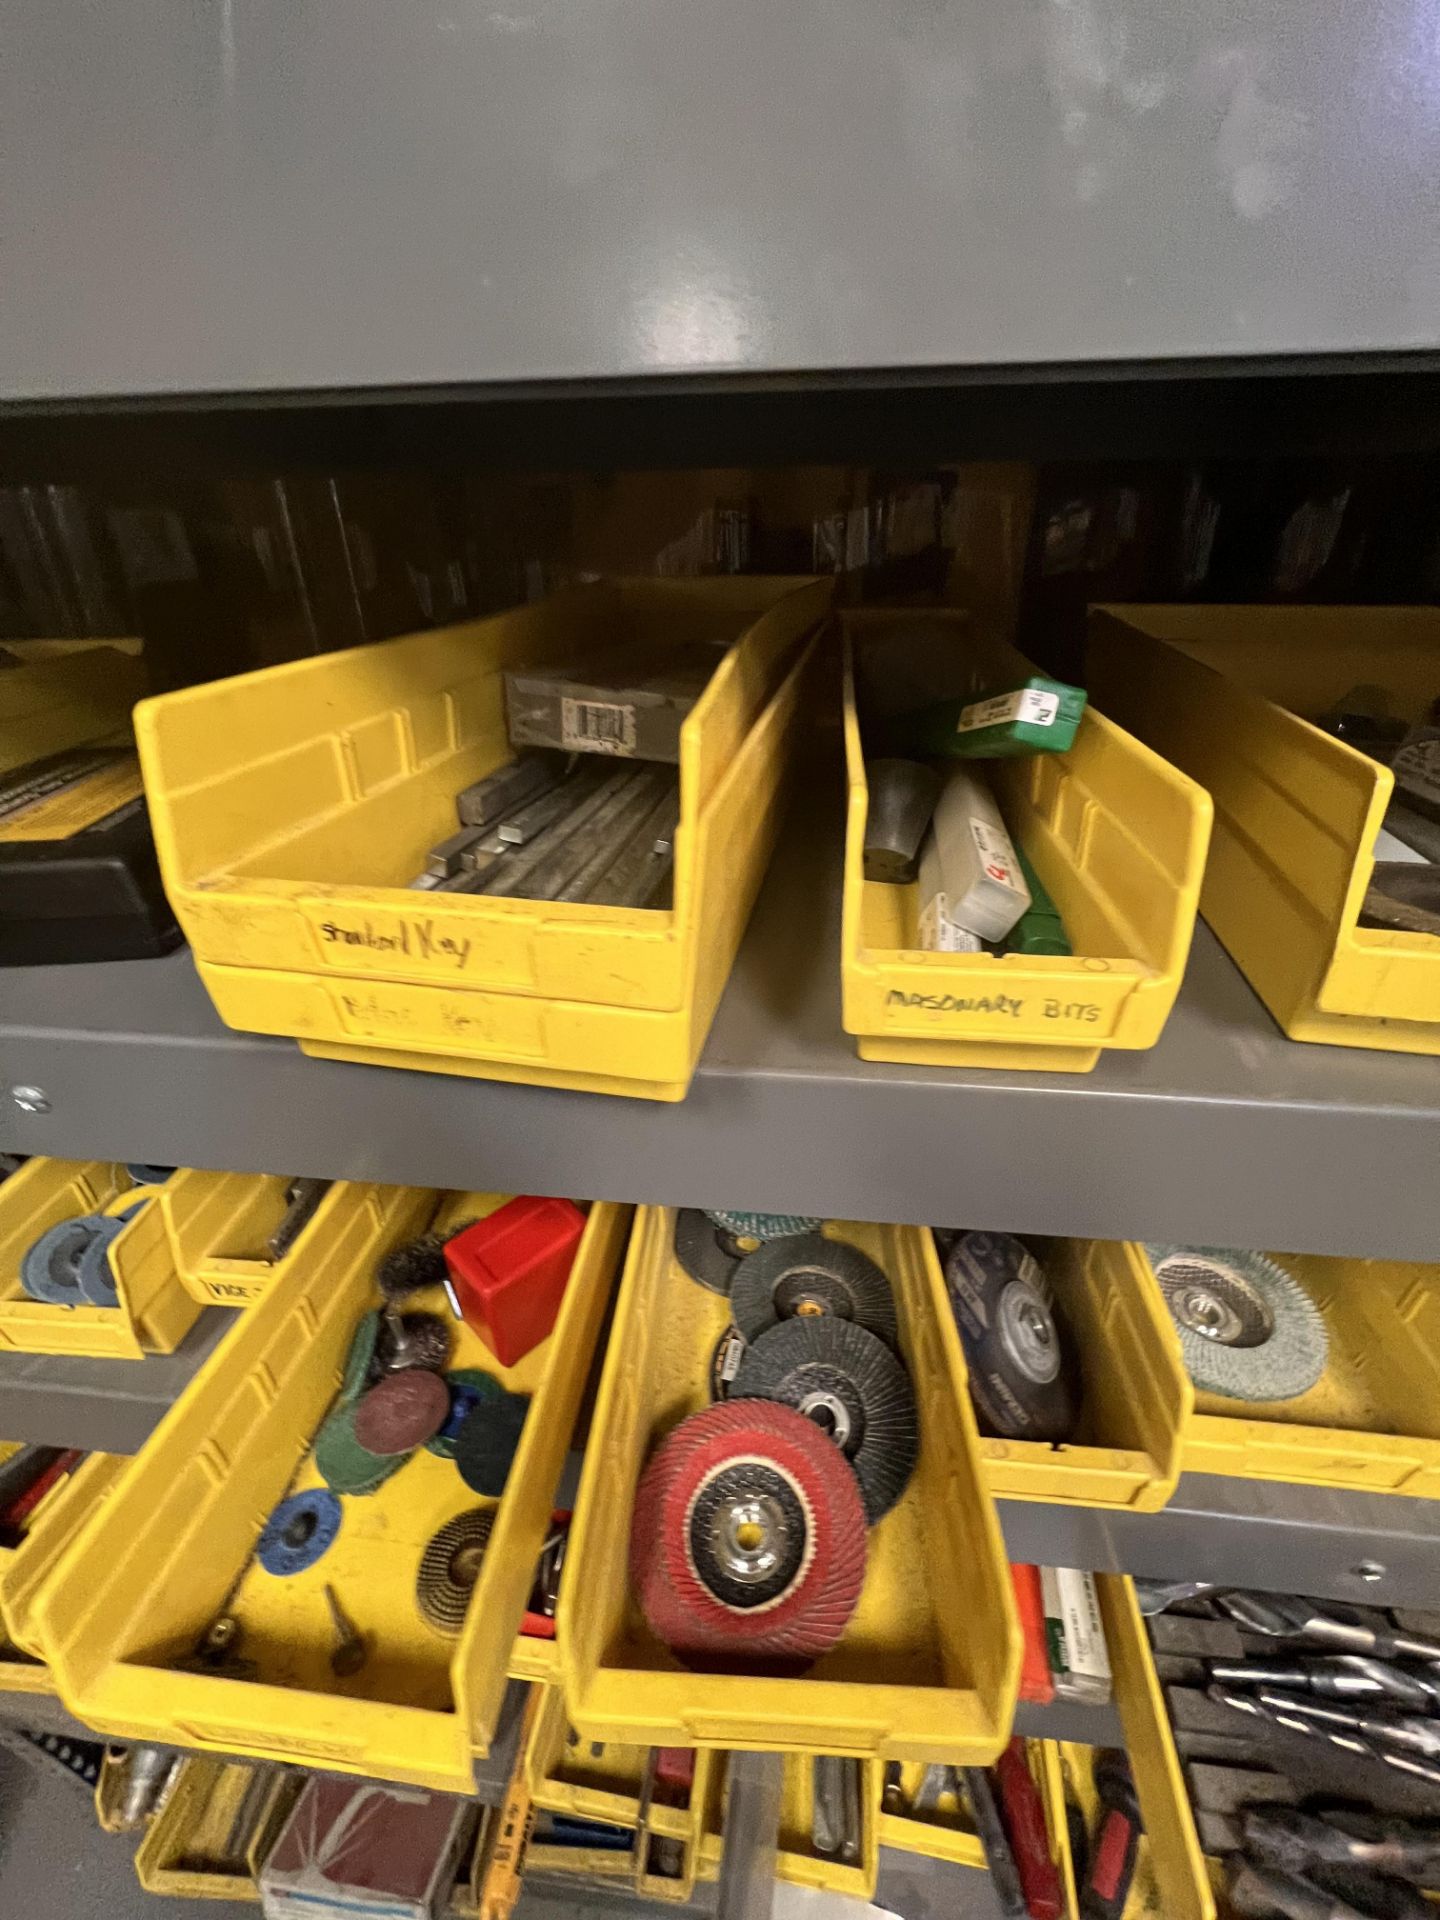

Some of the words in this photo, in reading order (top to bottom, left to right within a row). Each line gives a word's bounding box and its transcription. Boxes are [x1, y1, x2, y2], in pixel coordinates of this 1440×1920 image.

[413, 919, 471, 969] Key
[886, 989, 1023, 1018] MASONARY
[1042, 998, 1100, 1023] BITS
